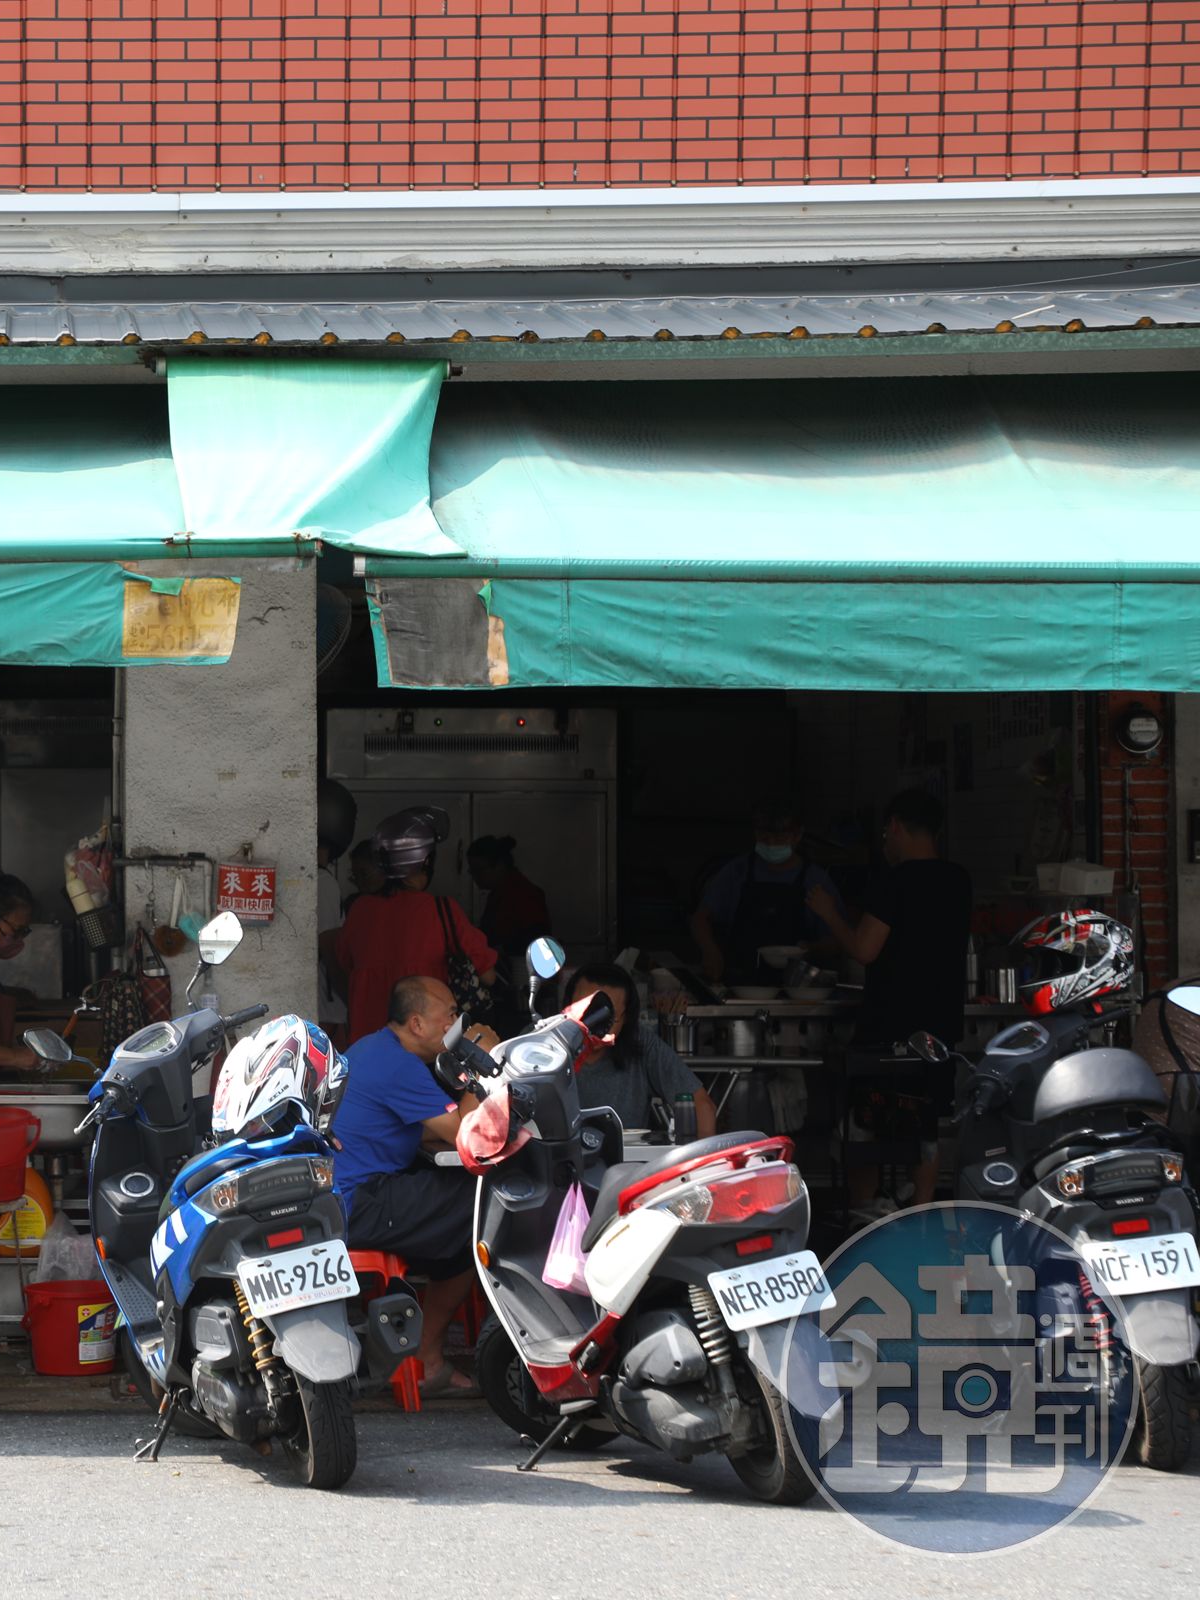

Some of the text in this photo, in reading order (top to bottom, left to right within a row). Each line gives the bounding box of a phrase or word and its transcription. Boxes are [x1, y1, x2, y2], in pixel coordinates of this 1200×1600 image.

[223, 872, 273, 896] 來來
[1115, 1196, 1145, 1206] SUZUKI
[270, 1205, 298, 1216] SUZUKI
